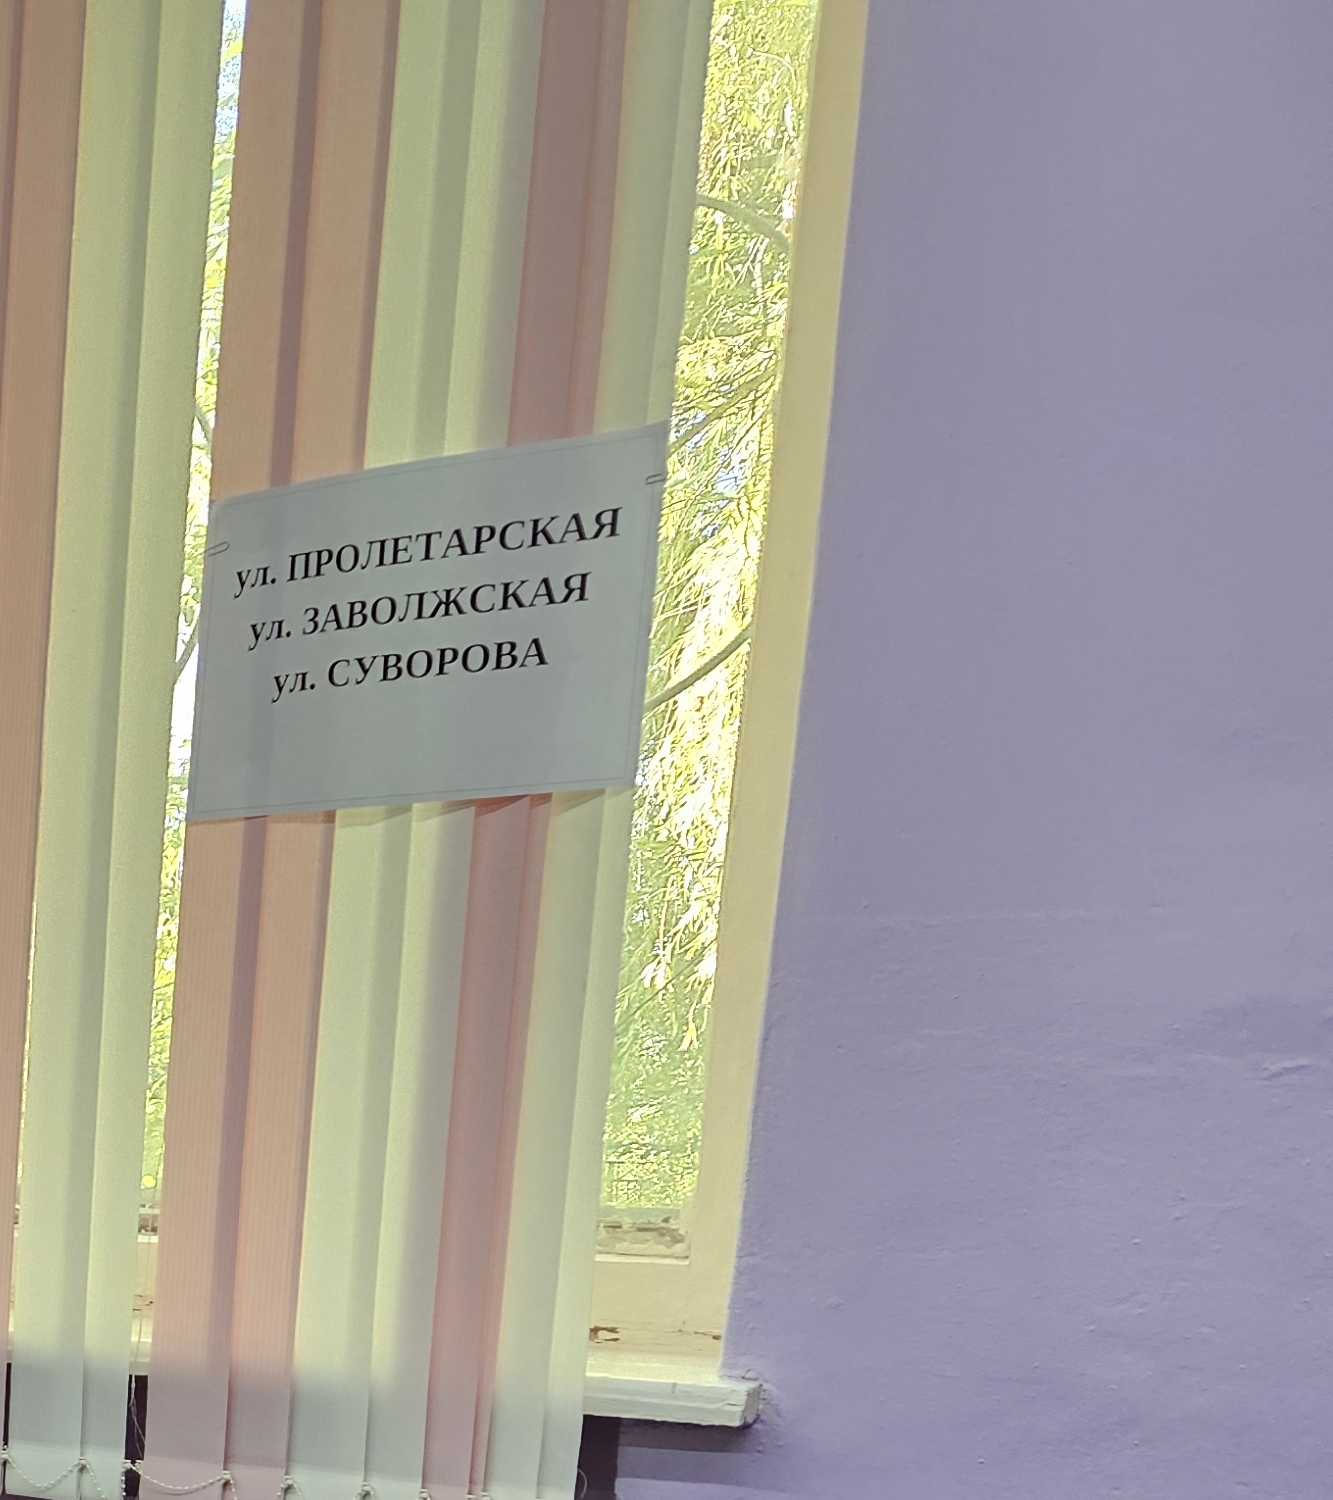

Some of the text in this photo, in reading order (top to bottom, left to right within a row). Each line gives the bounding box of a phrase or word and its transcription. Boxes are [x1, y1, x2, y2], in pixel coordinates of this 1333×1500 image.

[233, 506, 623, 599] ул. ПРОЛЕТАРСКАЯ
[247, 571, 592, 651] ул. ЗАВОЛЖСКАЯ
[271, 637, 549, 703] ул. СУВОРОВА
